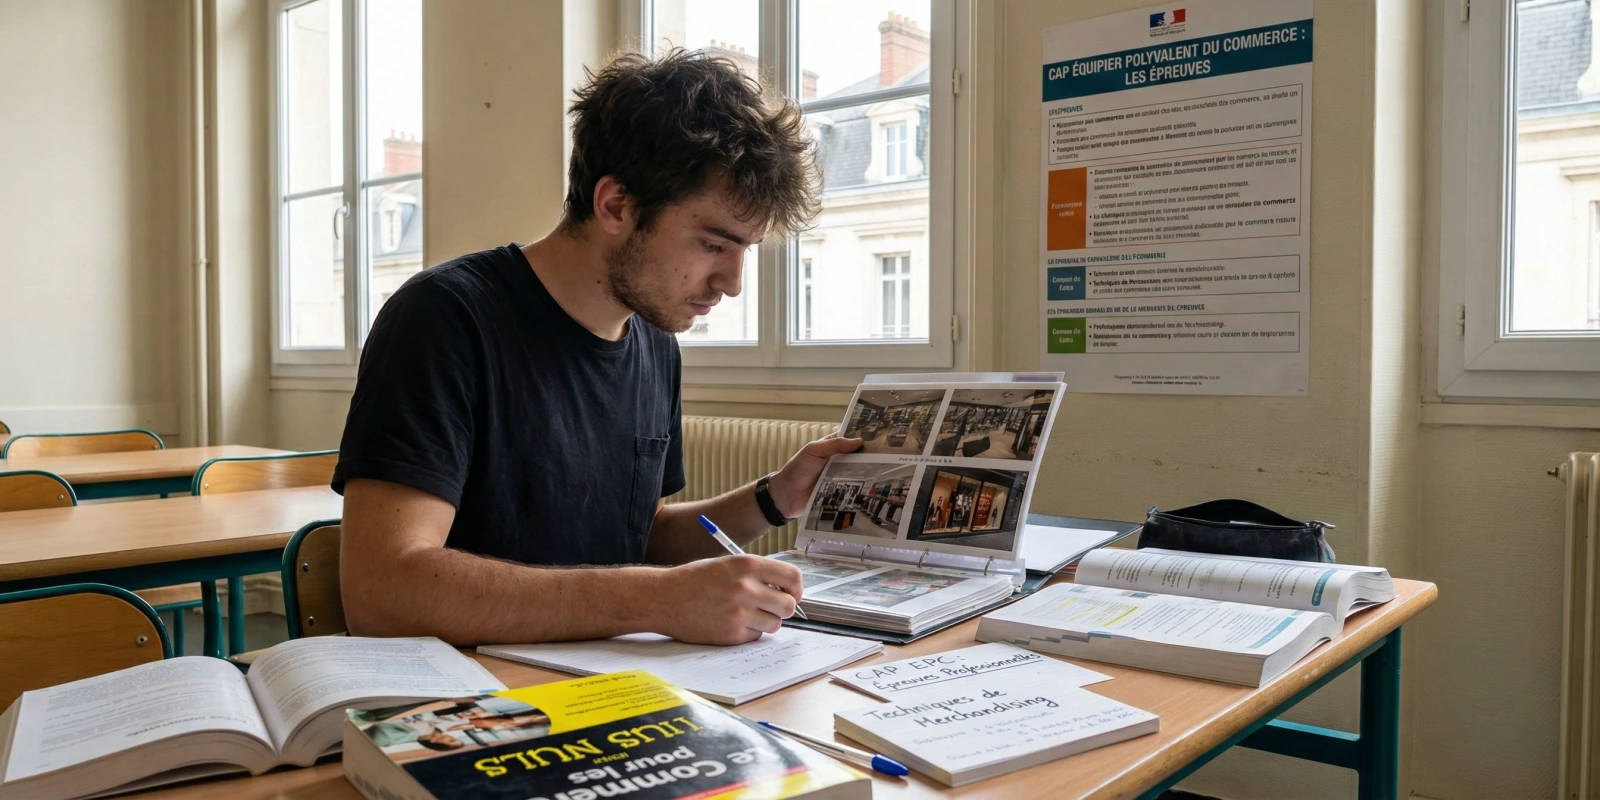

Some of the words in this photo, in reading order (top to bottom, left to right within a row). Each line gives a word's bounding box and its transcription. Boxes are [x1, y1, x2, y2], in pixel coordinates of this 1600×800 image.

[1048, 64, 1070, 81] CAP
[1072, 57, 1122, 78] ÉQUIPIER
[1125, 44, 1200, 69] POLYVALENT
[1203, 40, 1220, 57] DU
[1223, 27, 1298, 52] COMMERCE
[1125, 70, 1146, 86] LES
[1149, 59, 1211, 82] ÉPREUVES
[855, 665, 898, 680] CAP
[909, 655, 955, 670] EPC
[872, 674, 939, 691] Épreuves
[862, 695, 975, 721] Techniques
[982, 688, 1007, 699] de
[913, 695, 1060, 728] Merchandising
[474, 738, 603, 778] NULS
[624, 745, 696, 773] pour
[527, 760, 727, 800] Commer
[567, 765, 622, 784] les
